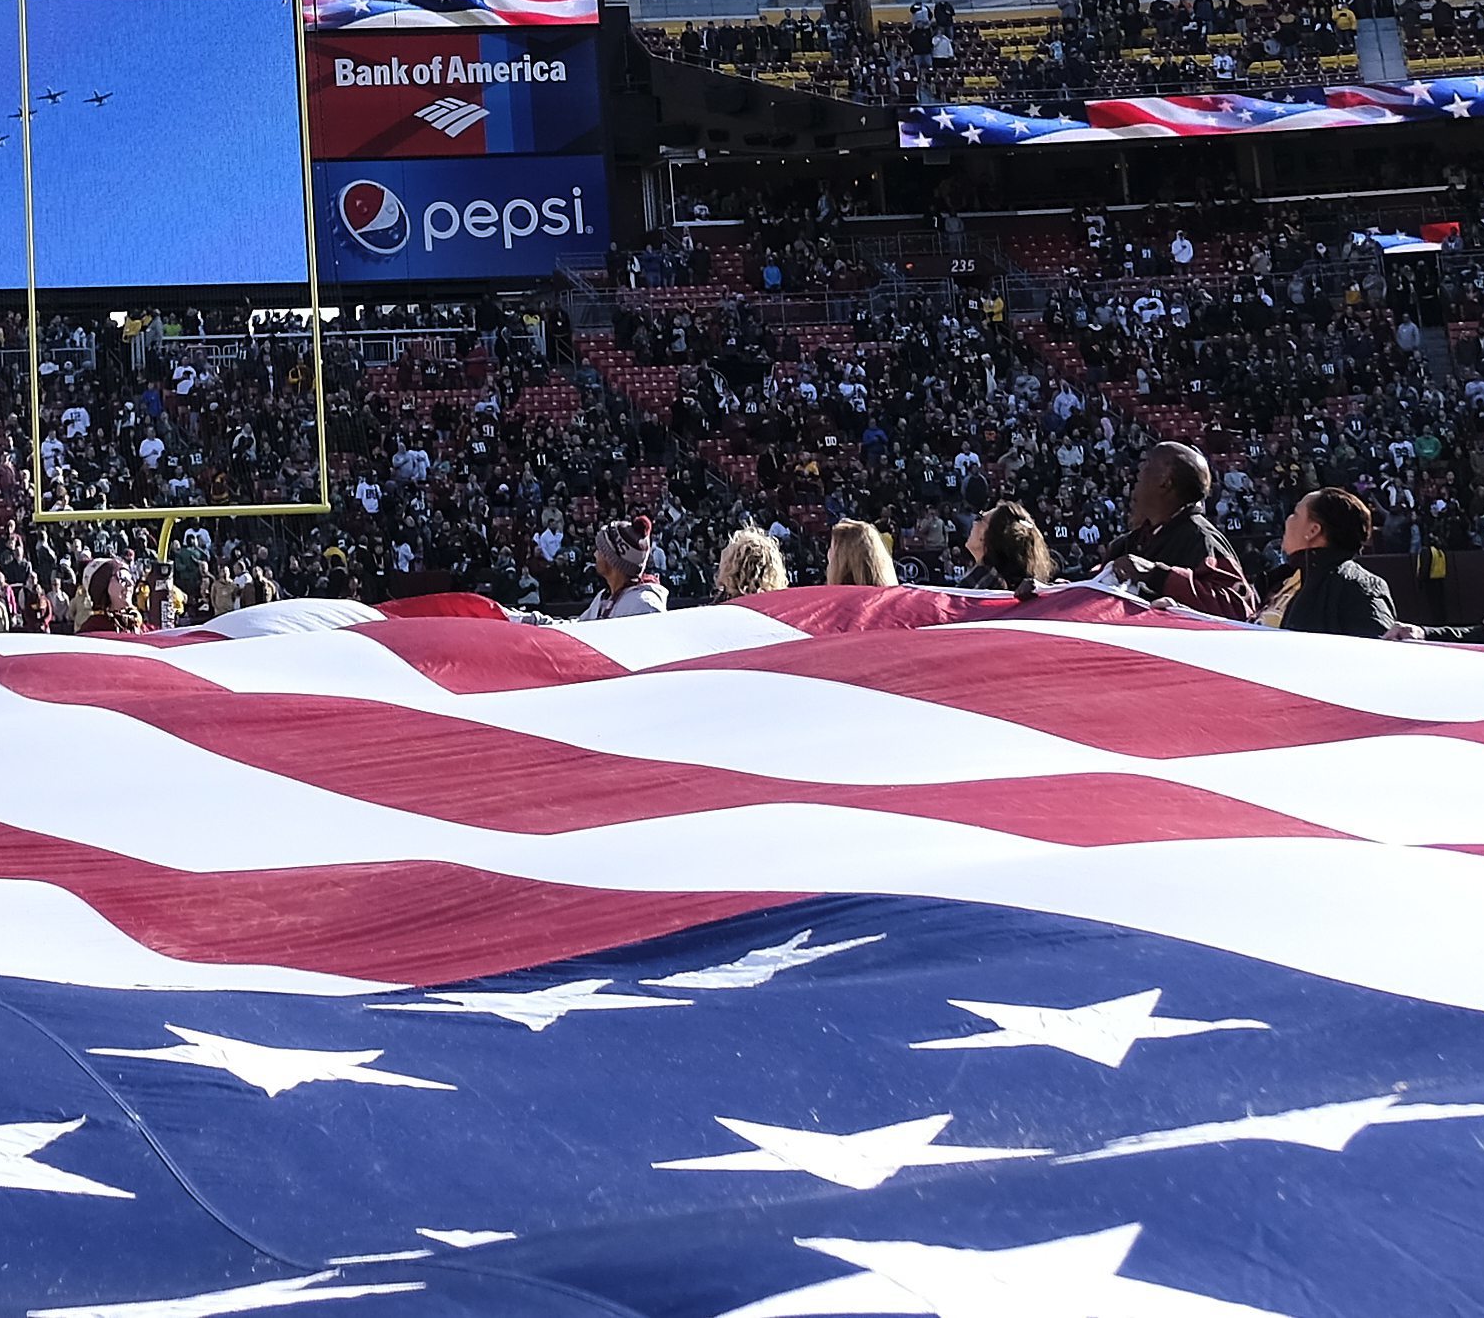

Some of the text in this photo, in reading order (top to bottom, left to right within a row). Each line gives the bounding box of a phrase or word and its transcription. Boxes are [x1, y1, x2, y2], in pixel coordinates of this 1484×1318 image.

[335, 54, 566, 86] Bank of America
[423, 187, 585, 252] pepsi
[951, 259, 975, 273] 235
